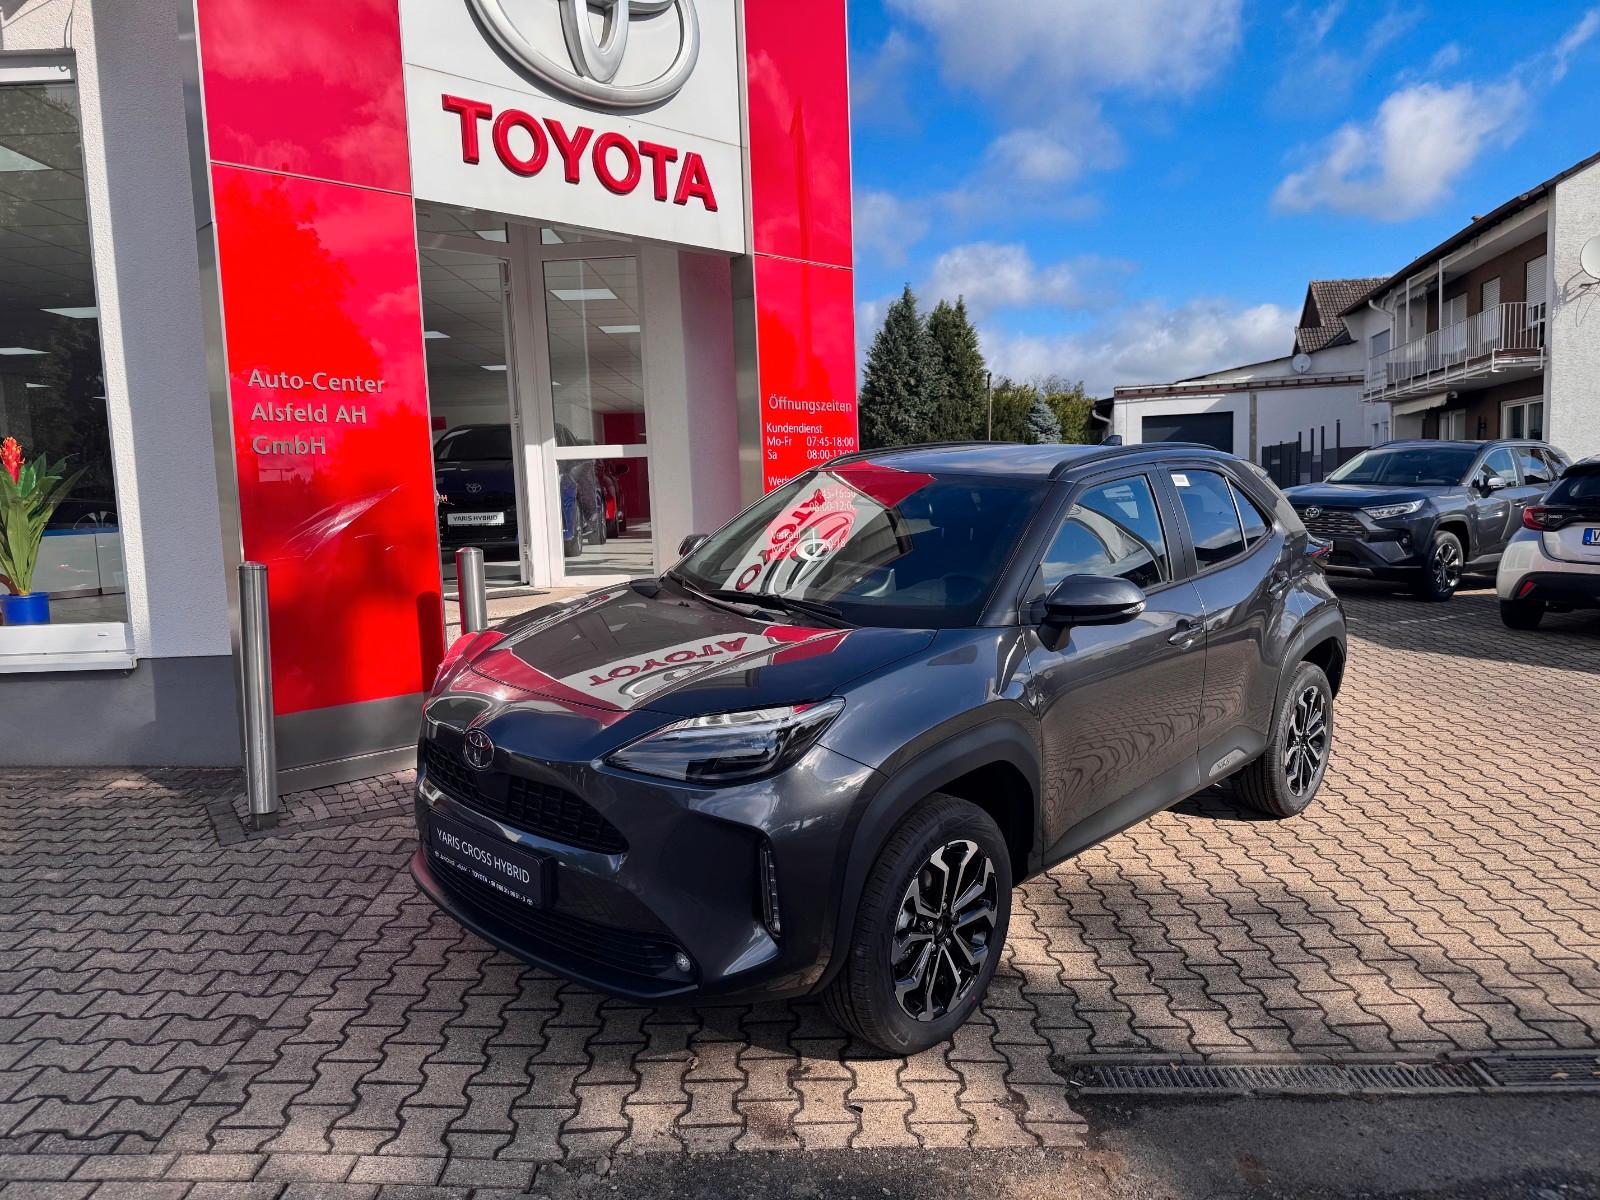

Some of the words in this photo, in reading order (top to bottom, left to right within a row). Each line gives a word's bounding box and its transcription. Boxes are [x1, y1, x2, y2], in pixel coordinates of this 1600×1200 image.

[441, 93, 718, 212] TOYOTA
[248, 368, 385, 393] Auto-Center
[251, 402, 328, 423] Alsfeld
[335, 405, 367, 424] AH
[768, 394, 852, 414] Öffnungszeiten
[766, 422, 823, 434] Kundendienst
[252, 435, 327, 455] GmbH
[767, 436, 792, 446] Mo-Fr
[806, 436, 854, 447] 07:45-18:00
[767, 449, 778, 460] Sa
[436, 827, 460, 850] YARIS
[461, 841, 492, 866] CROSS
[493, 856, 530, 883] HYBRID
